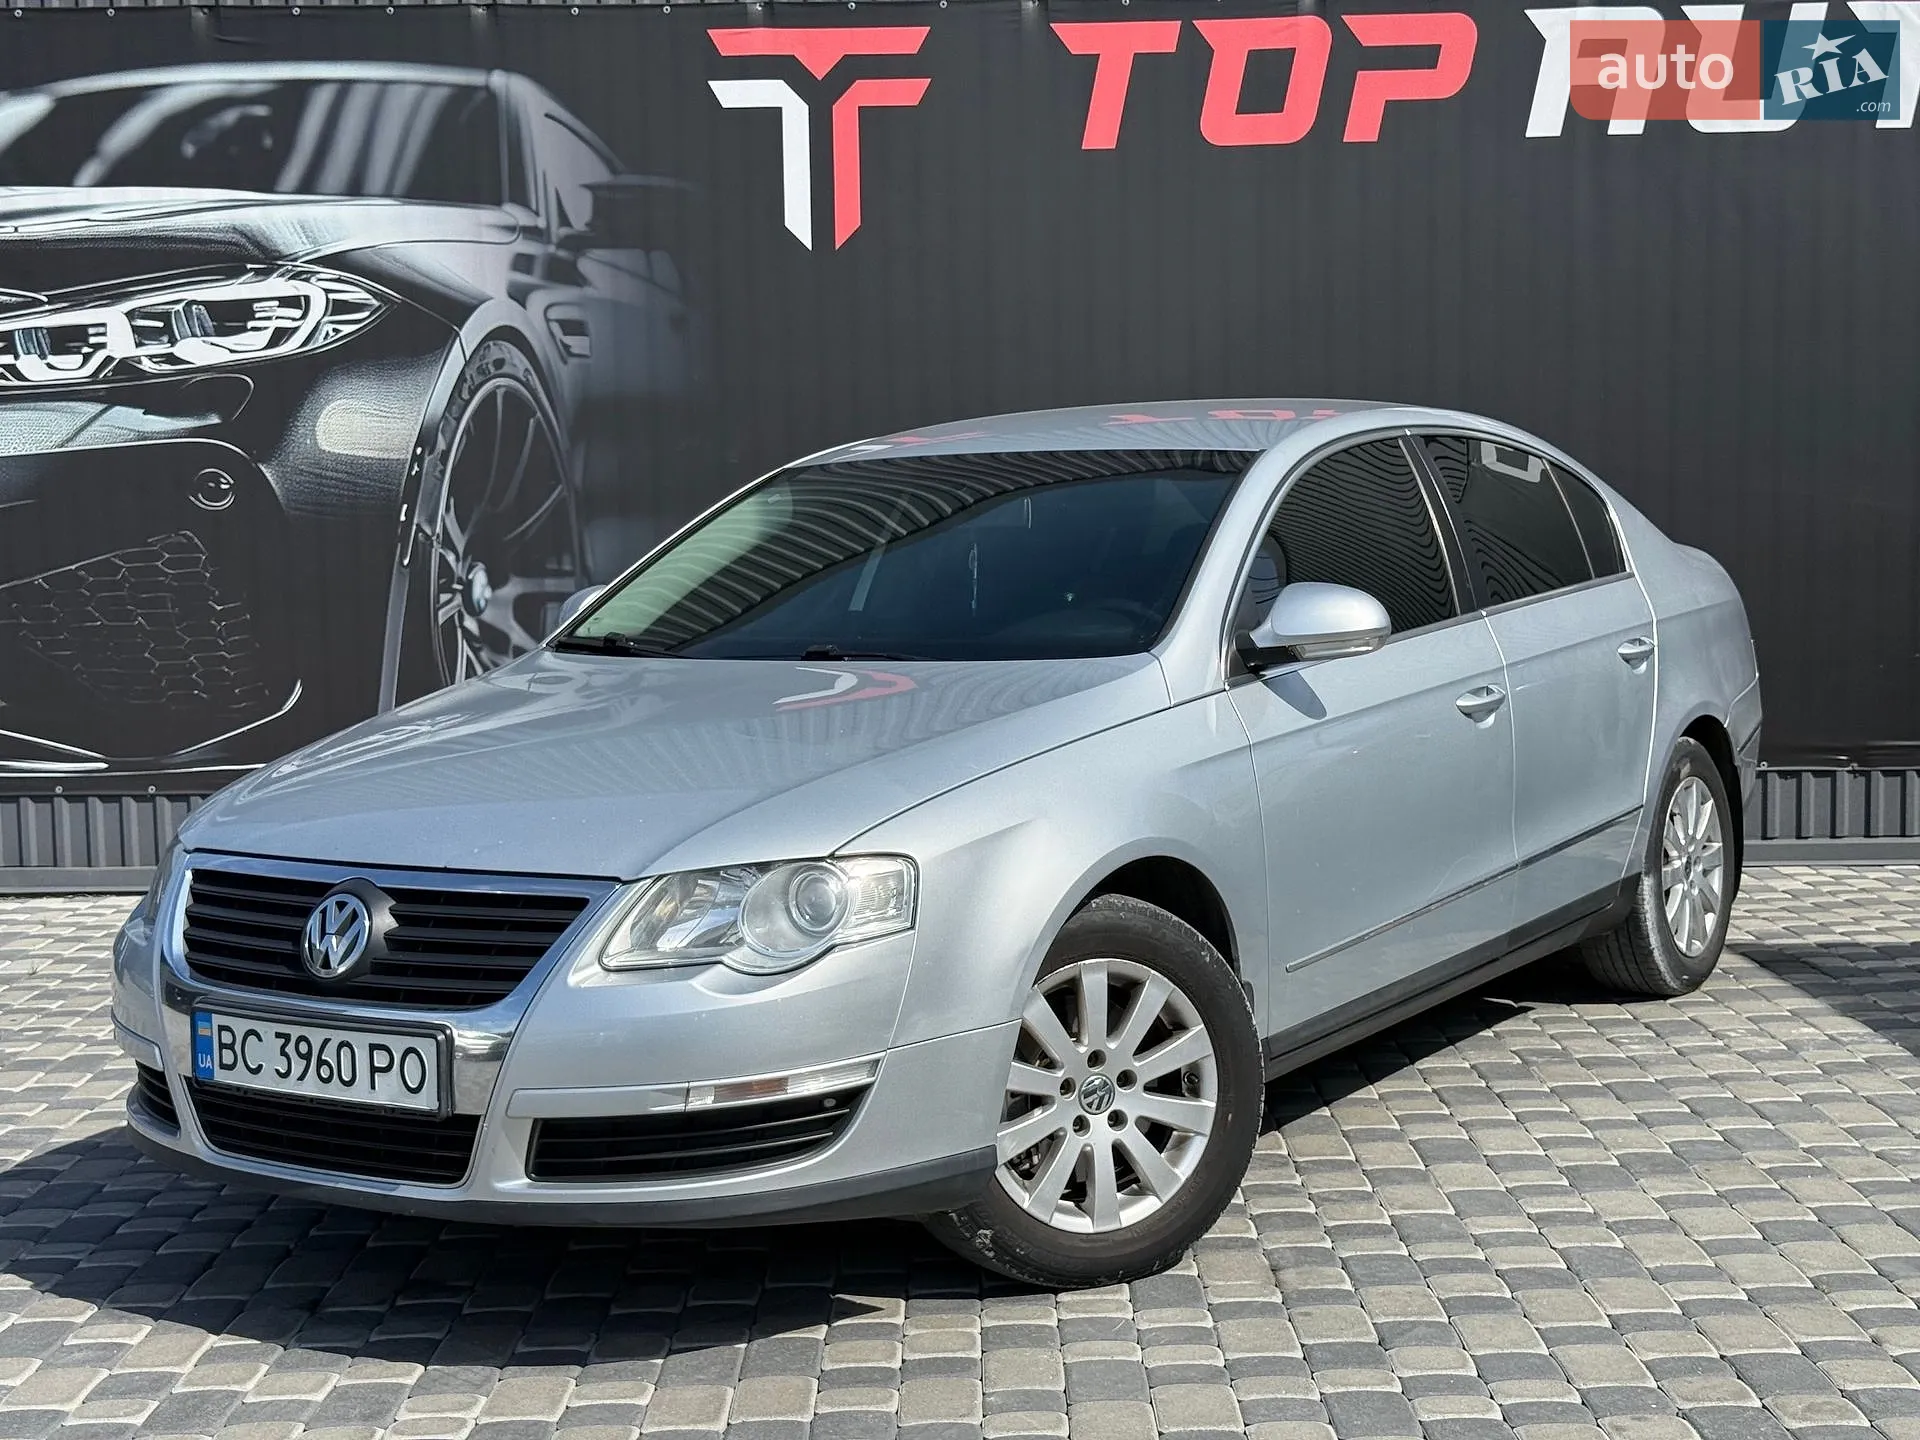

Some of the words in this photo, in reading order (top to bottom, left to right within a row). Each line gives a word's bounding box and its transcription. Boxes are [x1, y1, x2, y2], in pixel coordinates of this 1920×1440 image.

[1051, 13, 1478, 150] TOP
[198, 1052, 213, 1070] UA
[217, 1024, 264, 1075] BC
[274, 1031, 357, 1087] 3960
[368, 1043, 427, 1095] PO
